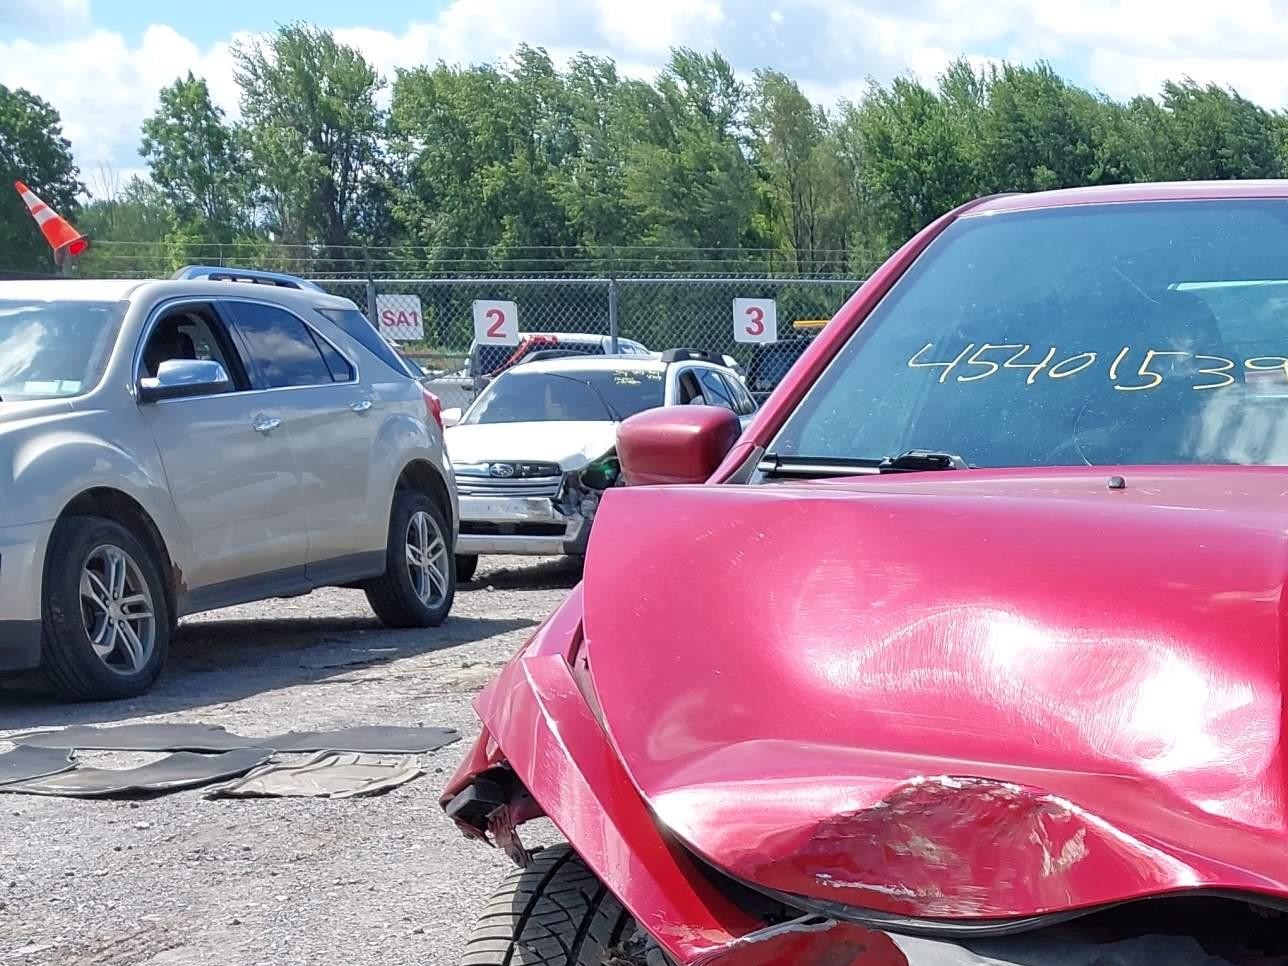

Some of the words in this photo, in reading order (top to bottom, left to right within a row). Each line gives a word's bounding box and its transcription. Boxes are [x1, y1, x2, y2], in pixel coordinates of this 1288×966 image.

[381, 309, 419, 328] SA1
[485, 309, 507, 338] 2
[744, 306, 766, 336] 3
